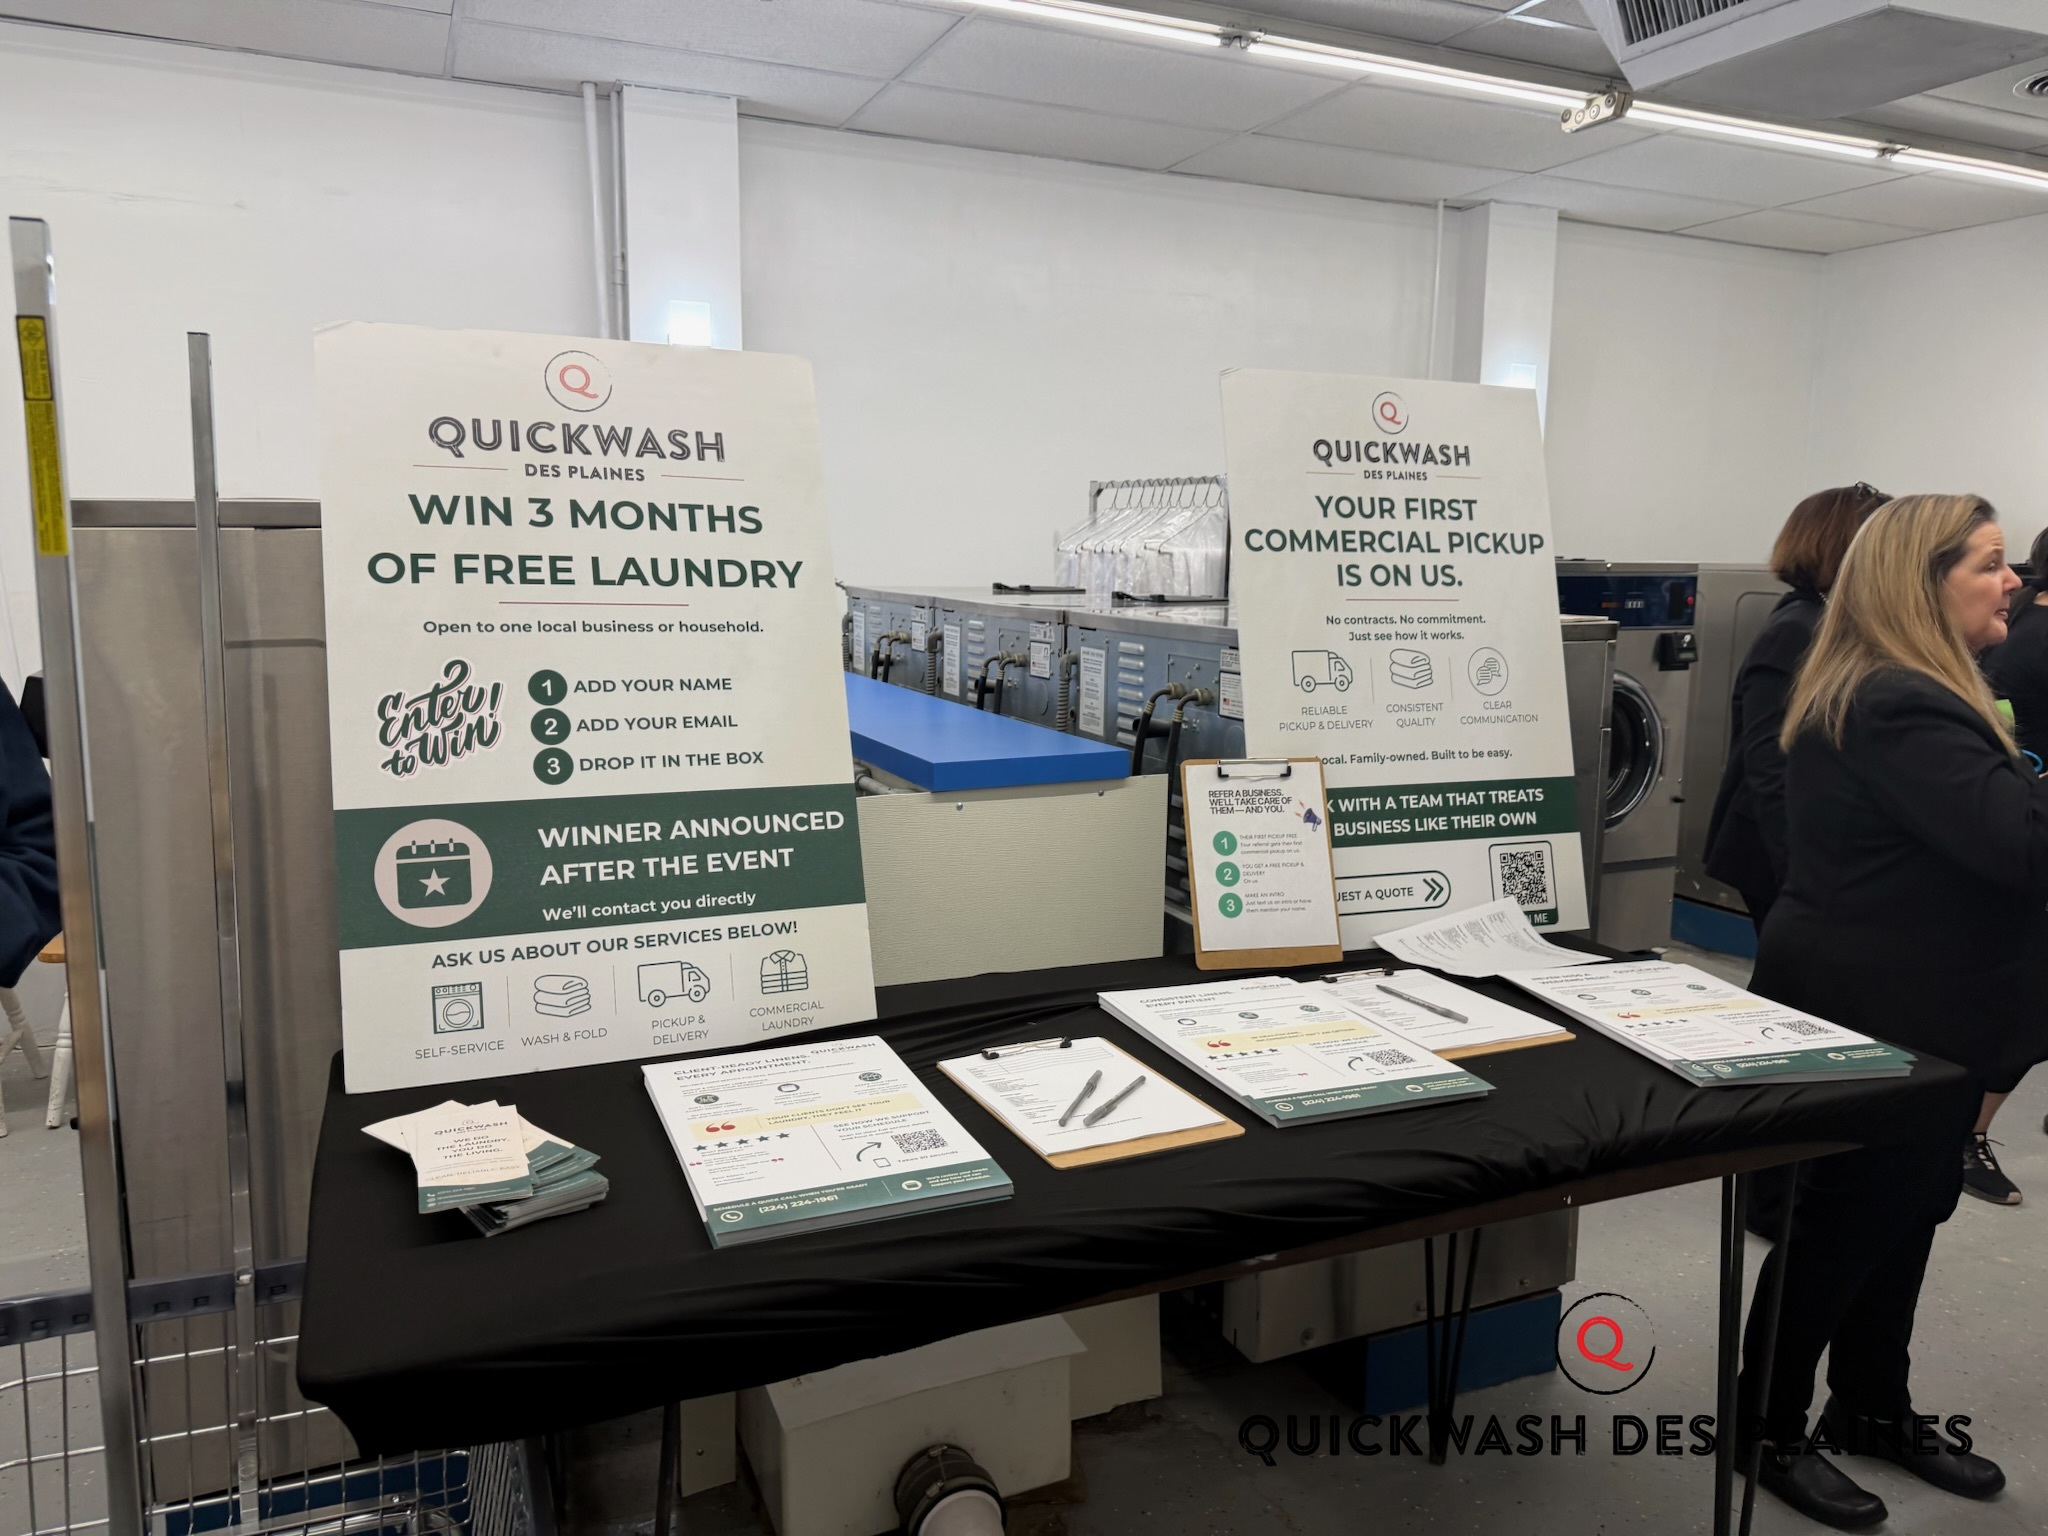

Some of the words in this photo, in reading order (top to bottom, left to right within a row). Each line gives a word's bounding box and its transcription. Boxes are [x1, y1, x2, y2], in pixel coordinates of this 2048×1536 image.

[559, 364, 599, 399] Q
[1379, 401, 1402, 425] Q
[428, 416, 726, 463] QUICKWASH
[1312, 438, 1471, 467] QUICKWASH
[524, 463, 562, 478] DES
[568, 465, 646, 481] PLAINES
[1363, 470, 1384, 480] DES
[1386, 471, 1428, 481] PLAINES
[407, 493, 512, 527] WIN
[528, 497, 554, 528] 3
[569, 499, 763, 535] MONTHS
[1315, 495, 1396, 520] YOUR
[1405, 498, 1478, 521] FIRST
[1244, 528, 1441, 554] COMMERCIAL
[1448, 531, 1545, 555] PICKUP
[367, 552, 436, 585] OF
[454, 554, 576, 586] FREE
[591, 556, 804, 589] LAUNDRY
[1337, 564, 1362, 587] IS
[1370, 564, 1411, 587] ON
[1420, 564, 1463, 587] US.
[423, 620, 472, 636] Open
[476, 621, 496, 634] to
[499, 623, 534, 634] one
[537, 620, 577, 633] local
[581, 620, 654, 633] business
[658, 623, 675, 633] or
[678, 620, 764, 633] household.
[1326, 615, 1341, 625] No
[1343, 615, 1398, 625] contracts.
[1399, 615, 1415, 624] No
[1417, 614, 1486, 624] commitment.
[1349, 631, 1372, 642] Just
[1394, 630, 1418, 640] how
[1420, 630, 1428, 640] it
[1430, 630, 1465, 640] works.
[541, 679, 552, 696] 1
[573, 679, 616, 693] ADD
[620, 678, 674, 693] YOUR
[678, 677, 733, 691] NAME
[377, 658, 504, 748] Enter!
[1301, 705, 1348, 716] RELIABLE
[1386, 702, 1444, 714] CONSISTENT
[1483, 700, 1512, 711] CLEAR
[543, 718, 558, 736] 2
[576, 717, 620, 732] ADD
[624, 716, 677, 731] YOUR
[682, 714, 738, 729] EMAIL
[1279, 721, 1316, 732] PICKUP
[1318, 720, 1325, 730] &
[1327, 719, 1374, 730] DELIVERY
[1396, 717, 1437, 729] QUALITY
[1460, 714, 1539, 725] COMMUNICATION
[381, 747, 417, 777] to
[406, 709, 501, 767] Win
[547, 757, 561, 775] 3
[579, 756, 635, 772] DROP
[640, 755, 657, 770] IT
[661, 754, 681, 768] IN
[684, 752, 722, 767] THE
[726, 750, 764, 765] BOX
[1319, 754, 1348, 766] ocal.
[1350, 751, 1429, 764] Family-owned.
[1431, 749, 1455, 760] Built
[1458, 750, 1470, 759] to
[1472, 749, 1485, 758] be
[1487, 750, 1513, 761] easy.
[1208, 790, 1233, 798] REFER
[1338, 797, 1380, 813] WITH
[1384, 797, 1396, 811] A
[1399, 793, 1444, 811] TEAM
[1446, 791, 1487, 809] THAT
[1489, 788, 1544, 807] TREATS
[1210, 806, 1234, 814] THEM
[537, 821, 662, 849] WINNER
[669, 810, 844, 841] ANNOUNCED
[1333, 819, 1412, 837] BUSINESS
[1415, 816, 1447, 833] LIKE
[1450, 813, 1495, 831] THEIR
[1498, 811, 1538, 828] OWN
[1221, 838, 1227, 849] 1
[539, 856, 635, 886] AFTER
[642, 853, 699, 878] THE
[706, 847, 794, 873] EVENT
[1224, 868, 1232, 880] 2
[1336, 890, 1362, 902] UEST
[1364, 890, 1373, 900] A
[1375, 887, 1414, 900] QUOTE
[591, 899, 657, 918] contact
[660, 898, 692, 915] you
[695, 891, 757, 912] directly
[1227, 899, 1235, 911] 3
[1534, 913, 1548, 923] ME
[431, 949, 474, 969] ASK
[478, 948, 505, 964] US
[510, 940, 581, 962] ABOUT
[585, 935, 629, 955] OUR
[633, 927, 723, 949] SERVICES
[727, 920, 799, 940] BELOW!
[749, 999, 824, 1019] COMMERCIAL
[651, 1016, 694, 1031] PICKUP
[697, 1014, 706, 1026] &
[761, 1015, 815, 1032] LAUNDRY
[520, 1031, 561, 1047] WASH
[563, 1030, 572, 1043] &
[573, 1027, 608, 1042] FOLD
[652, 1029, 710, 1046] DELIVERY
[414, 1038, 505, 1060] SELF-SERVICE
[677, 1072, 717, 1081] EVERY
[721, 1061, 811, 1074] APPOINTMENT.
[434, 1121, 507, 1135] QUICKWASH
[759, 1203, 788, 1213] (224)
[791, 1195, 839, 1208] 224-1961
